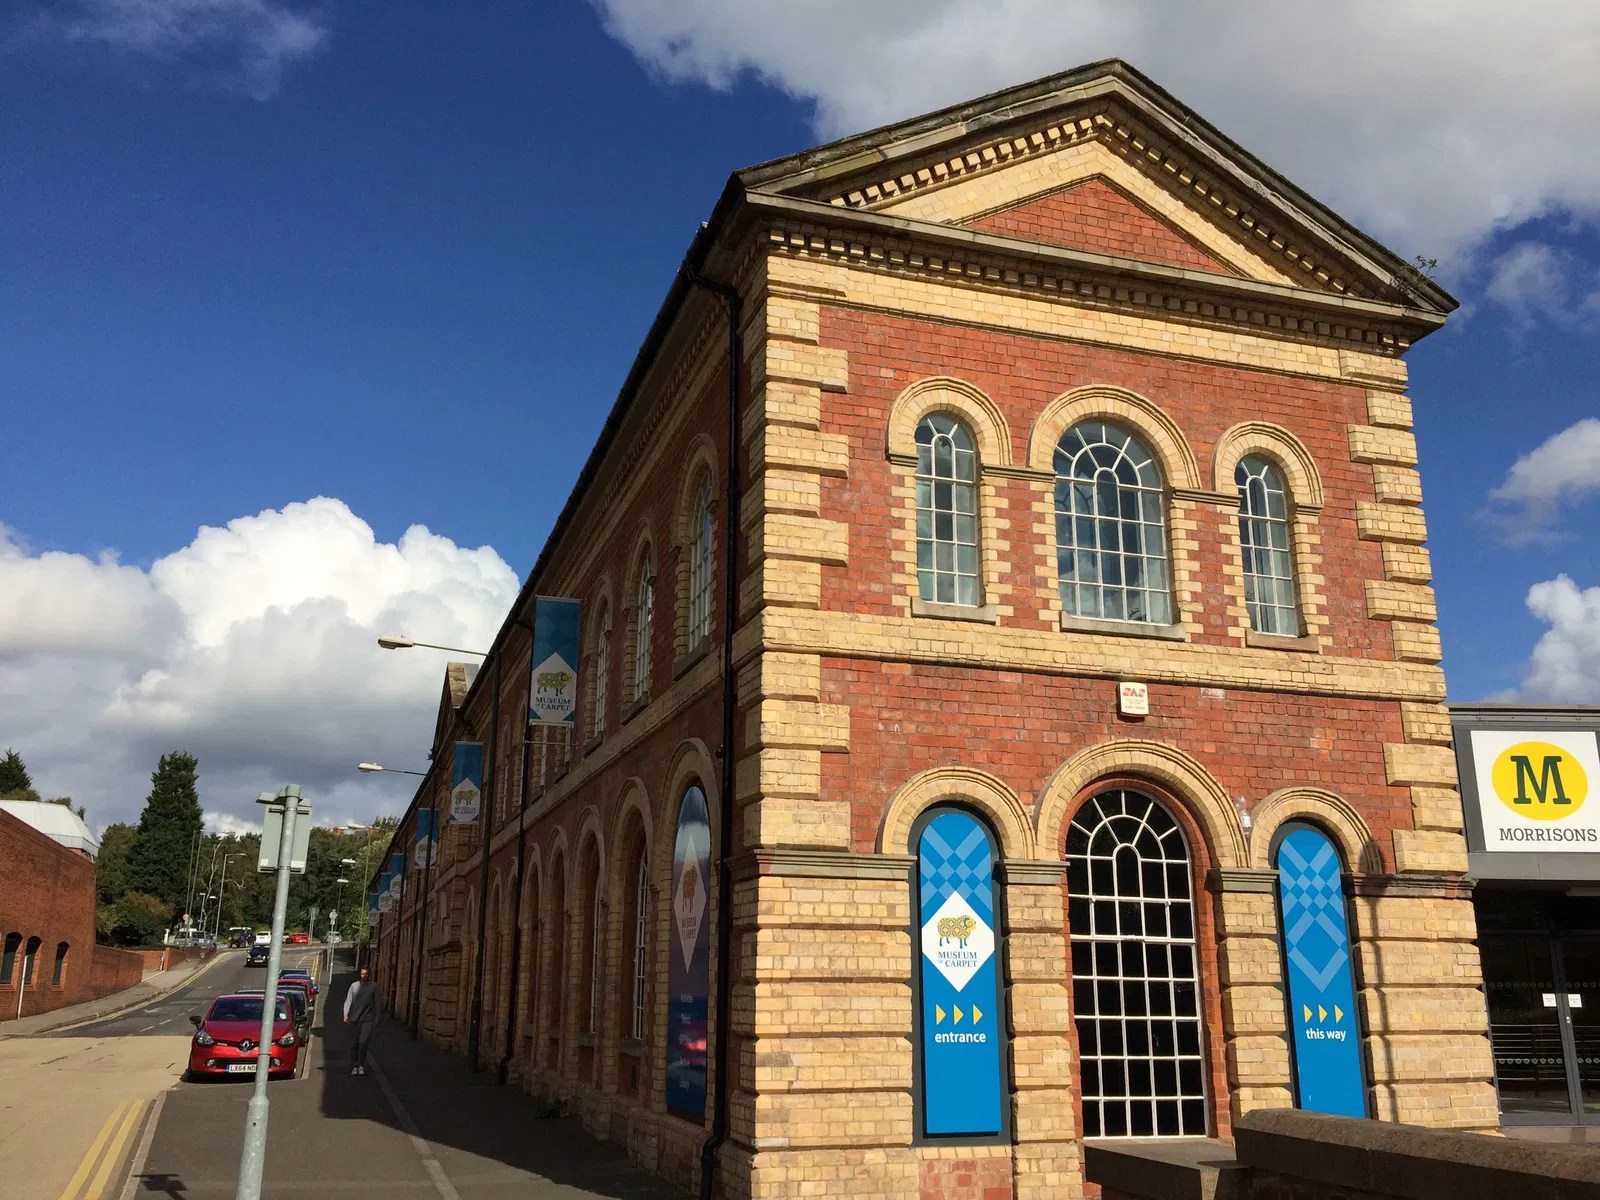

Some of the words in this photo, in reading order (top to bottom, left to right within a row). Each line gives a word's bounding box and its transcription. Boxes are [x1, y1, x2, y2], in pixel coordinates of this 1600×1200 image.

[535, 696, 571, 705] MUSEUM
[541, 703, 570, 711] CARPET
[1510, 755, 1572, 805] M
[1499, 828, 1598, 842] MORRISONS
[938, 951, 978, 960] MUSEUM
[945, 960, 978, 968] CARPET
[934, 1032, 987, 1043] entrance
[1305, 1027, 1325, 1040] this
[1326, 1030, 1347, 1042] way
